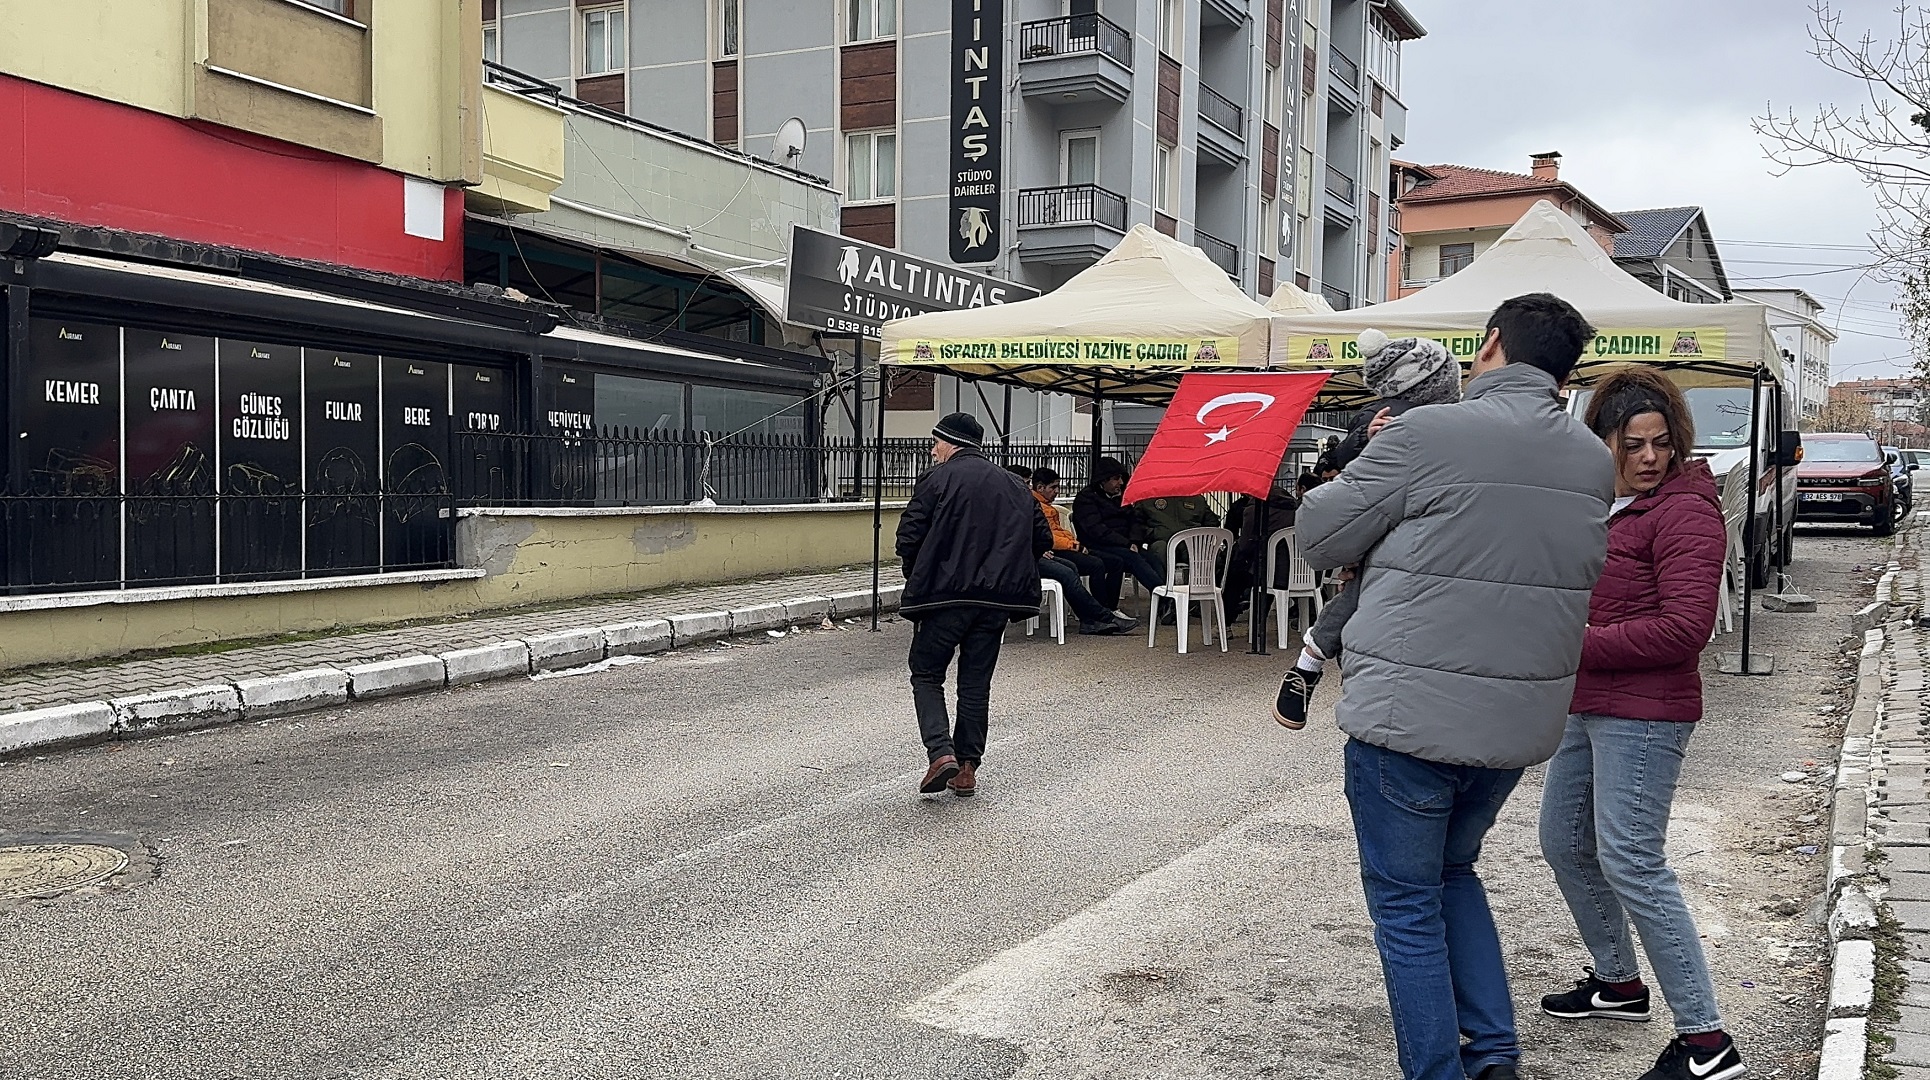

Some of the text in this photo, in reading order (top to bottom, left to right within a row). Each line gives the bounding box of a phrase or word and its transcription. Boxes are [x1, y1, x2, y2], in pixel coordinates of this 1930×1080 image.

[957, 168, 992, 182] STÜDYO
[827, 317, 882, 337] 0 532 615
[940, 338, 1188, 362] ISPARTA BELEDİYESİ TAZİYE ÇADIRI
[1594, 335, 1660, 357] ÇADIRI
[45, 380, 100, 405] KEMER
[150, 387, 196, 411] ÇANTA
[240, 392, 282, 418] GÜNEŞ
[325, 401, 362, 422] FULAR
[404, 407, 431, 426] BERE
[233, 416, 289, 440] GÖZLÜĞÜ
